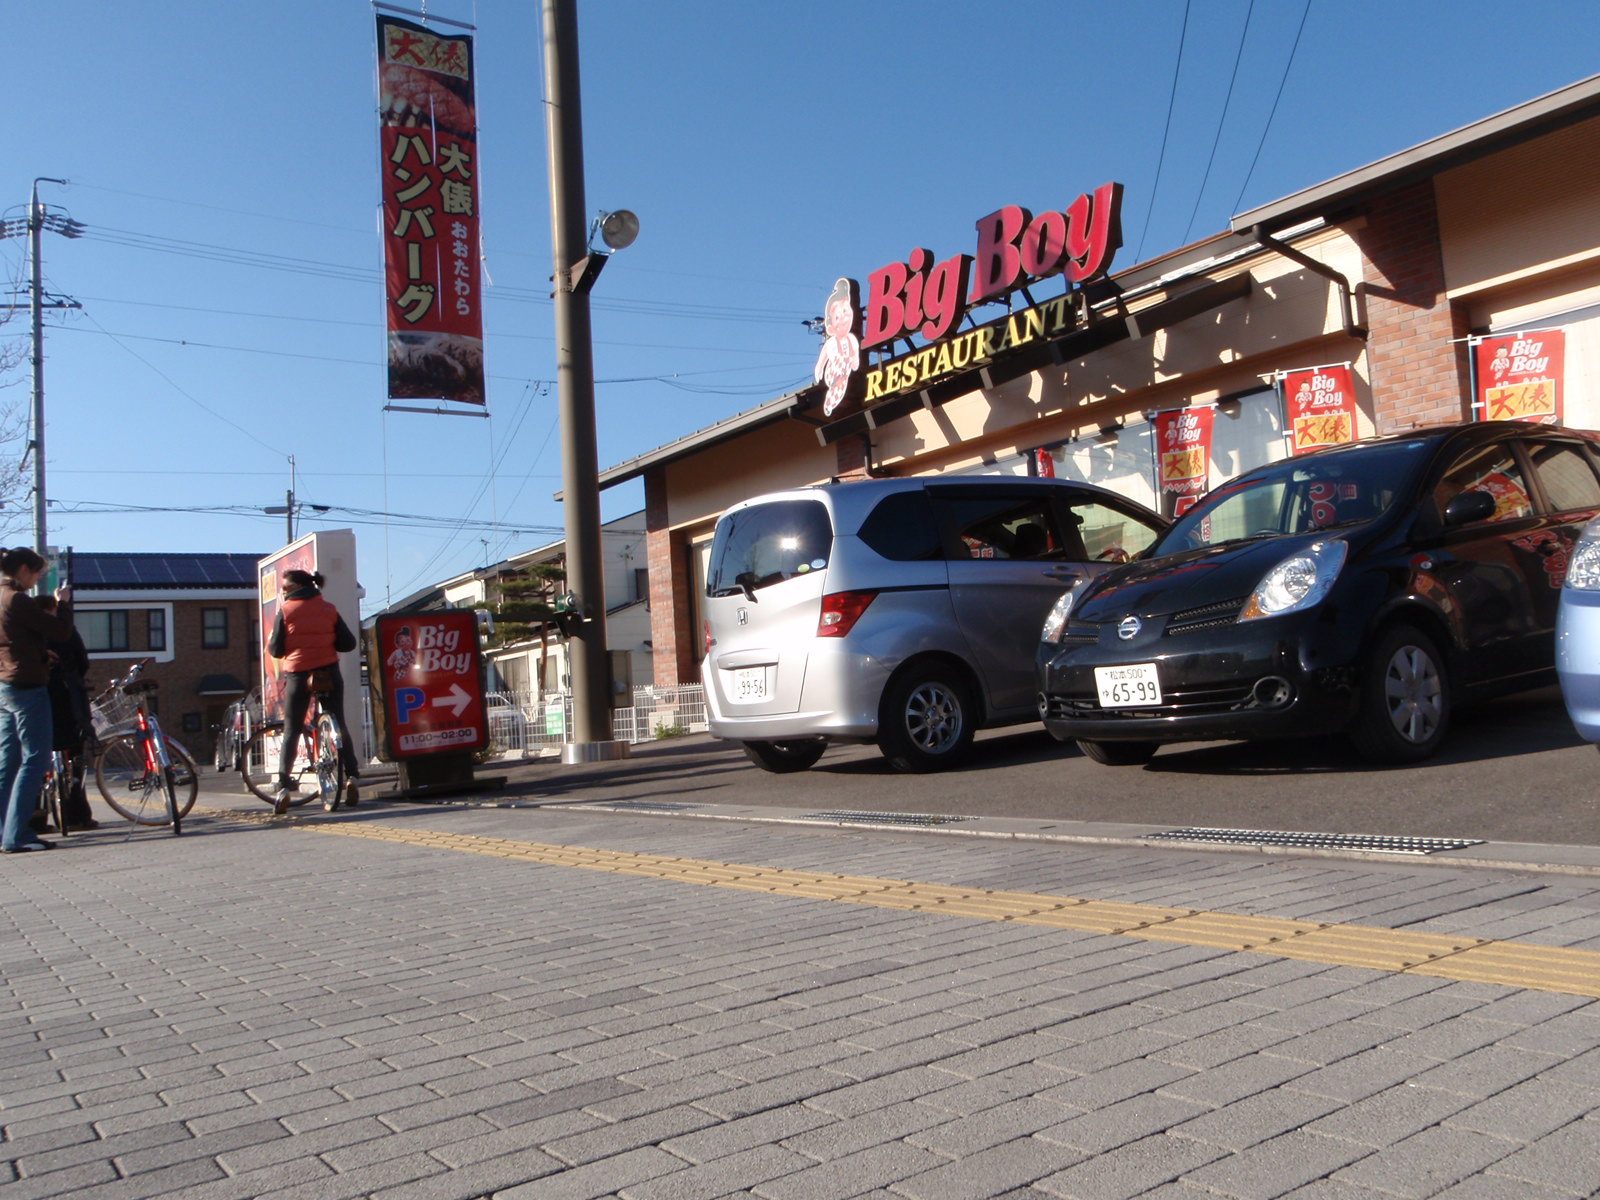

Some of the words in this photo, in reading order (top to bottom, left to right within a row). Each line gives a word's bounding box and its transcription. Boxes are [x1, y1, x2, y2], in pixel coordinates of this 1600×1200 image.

[439, 142, 473, 217] 大俵
[391, 134, 435, 324] ハンバーグ
[451, 221, 471, 316] おおたわら
[861, 246, 972, 350] Big
[968, 181, 1122, 303] Boy
[864, 295, 1074, 402] RESTAURANT
[1509, 339, 1543, 358] Big
[1510, 356, 1549, 373] Boy
[1311, 374, 1335, 392] Big
[1312, 390, 1343, 406] Boy
[1176, 413, 1198, 429] Big
[1178, 428, 1202, 442] Boy
[418, 624, 460, 651] Big
[421, 649, 471, 675] Boy
[1112, 682, 1157, 702] 65-99
[395, 687, 425, 725] P
